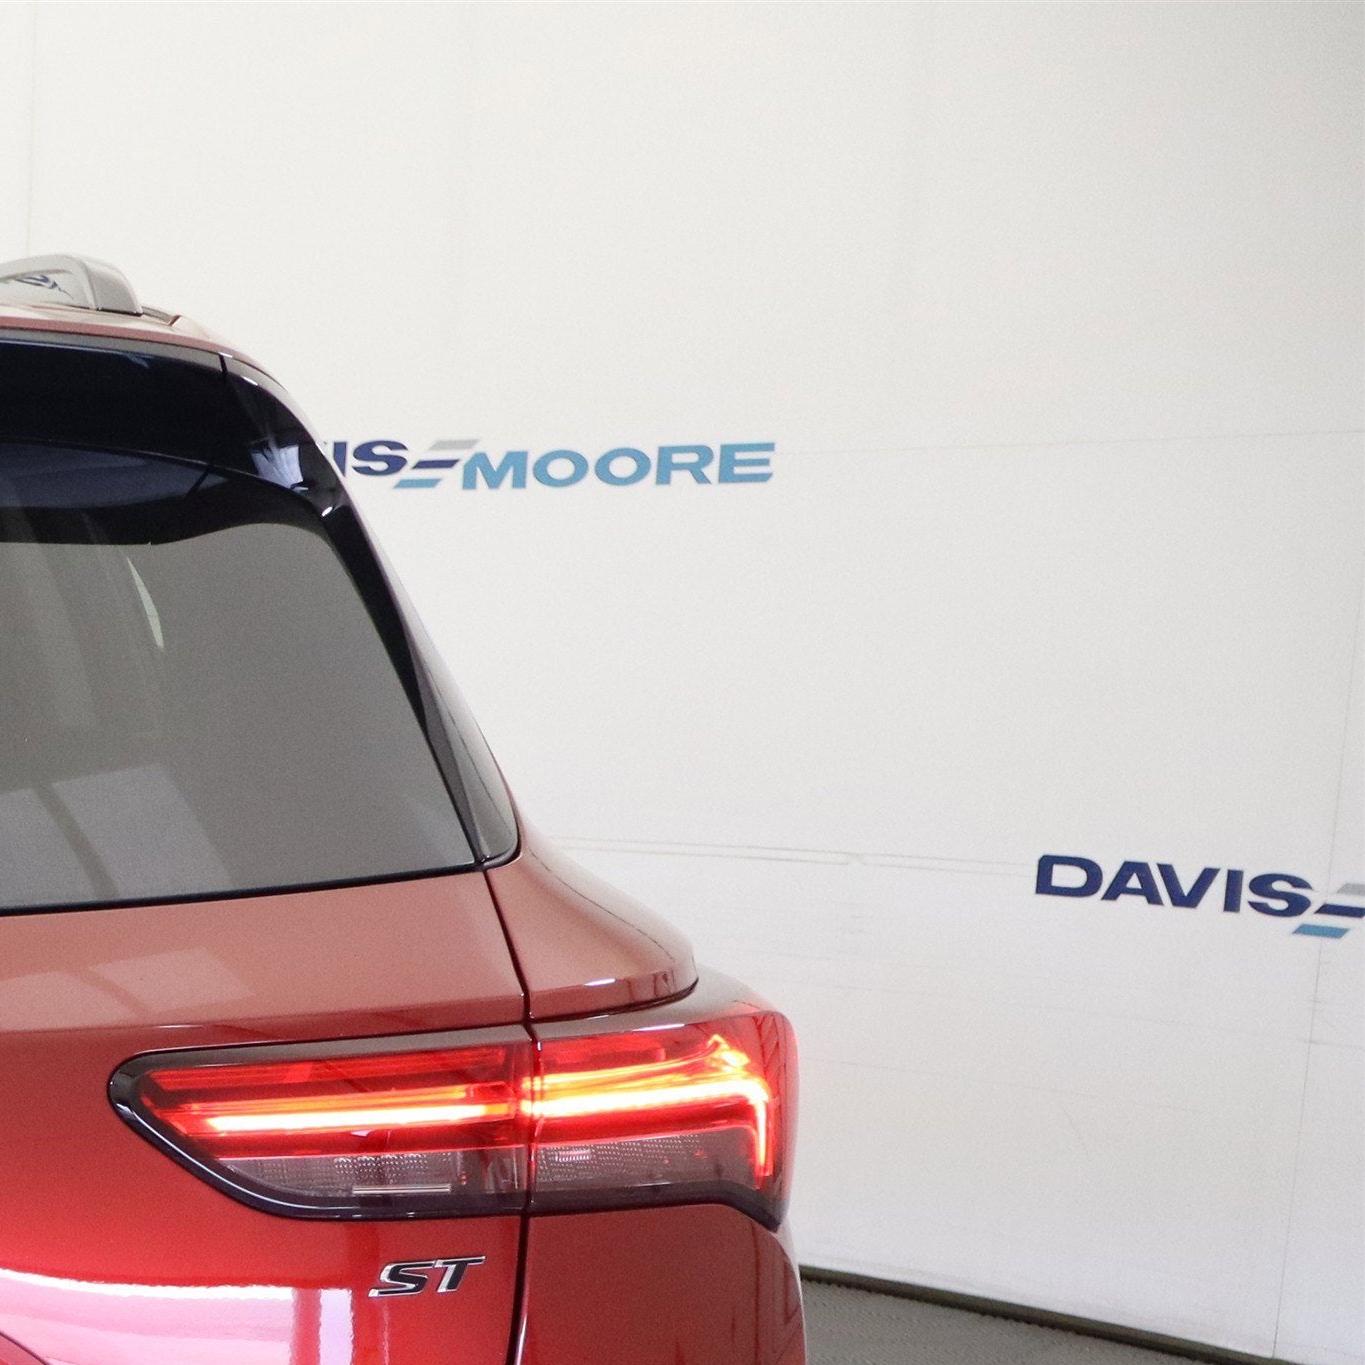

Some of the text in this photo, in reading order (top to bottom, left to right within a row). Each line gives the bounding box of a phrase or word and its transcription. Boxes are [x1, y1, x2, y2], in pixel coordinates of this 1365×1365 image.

[461, 442, 776, 490] MOORE
[1035, 855, 1314, 918] DAVIS
[368, 1255, 487, 1297] ST
